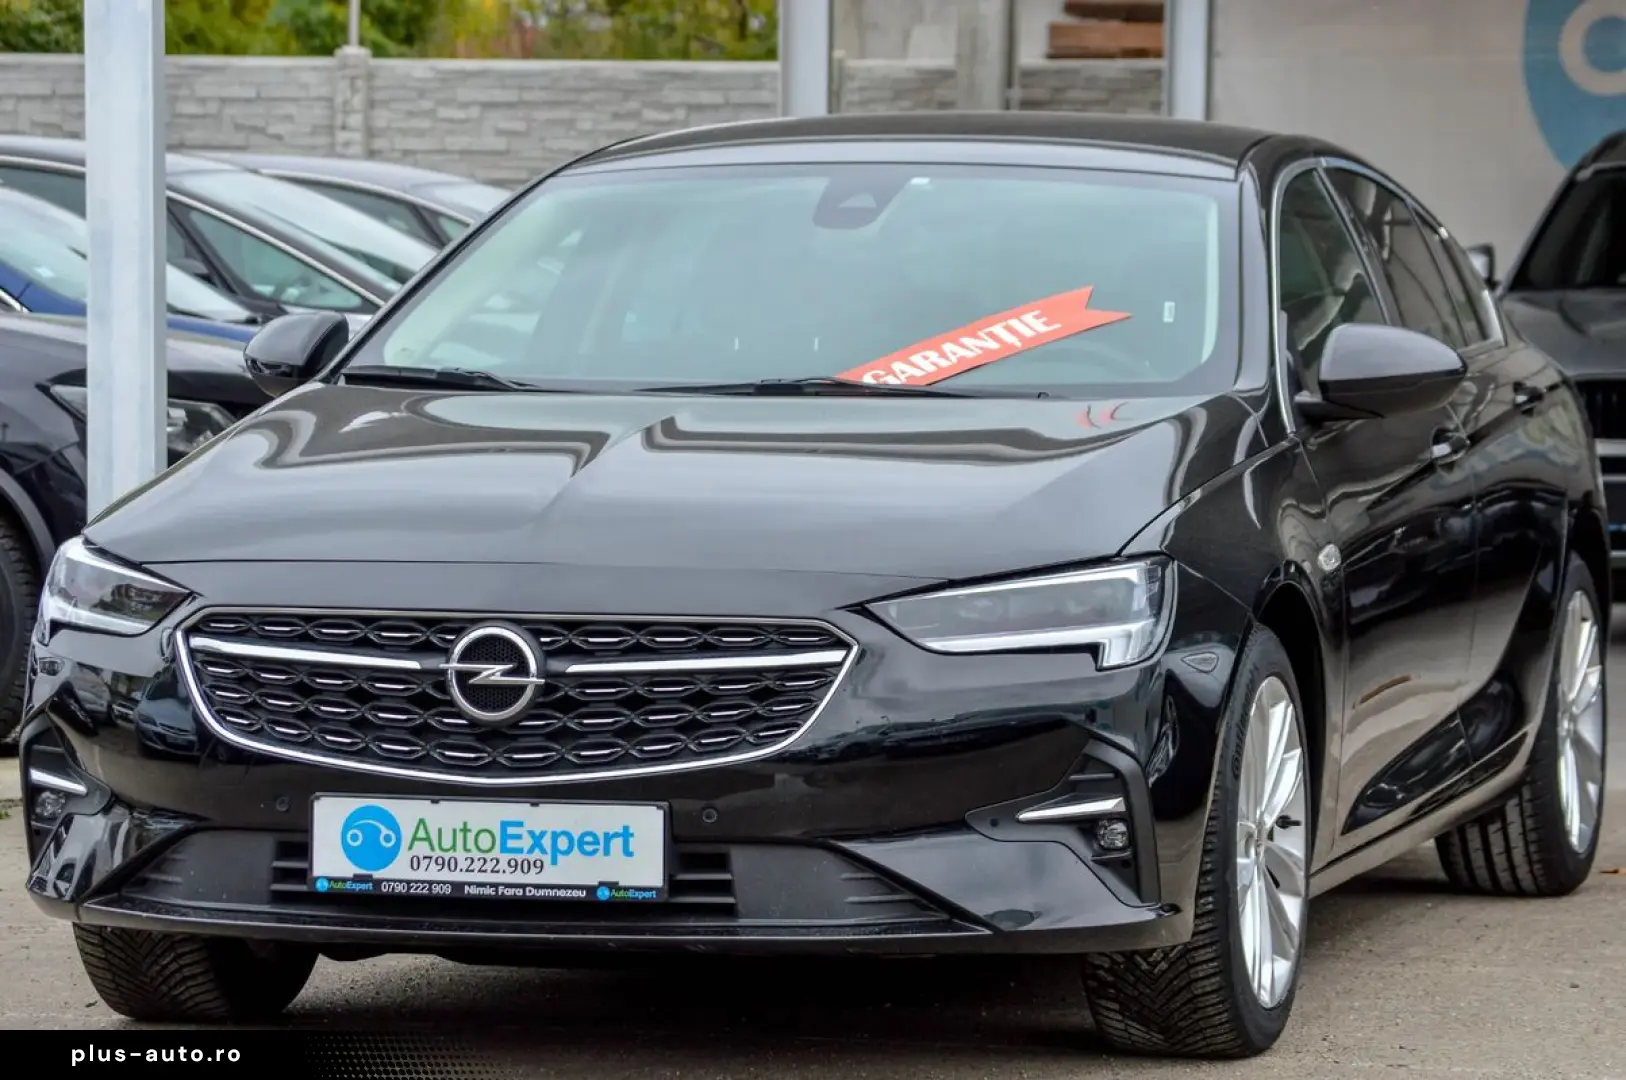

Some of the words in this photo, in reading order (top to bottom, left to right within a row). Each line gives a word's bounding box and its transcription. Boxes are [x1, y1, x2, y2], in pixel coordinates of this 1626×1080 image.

[407, 818, 635, 866] AutoExpert
[410, 855, 544, 875] 0790.222.909
[330, 880, 373, 891] AutoExpert
[381, 881, 408, 893] 0790
[410, 882, 430, 894] 222
[431, 883, 452, 895] 909
[464, 884, 496, 896] Nimic
[498, 886, 523, 897] Fara
[525, 886, 587, 898] Dumnezeu
[611, 888, 656, 899] AutoExpert
